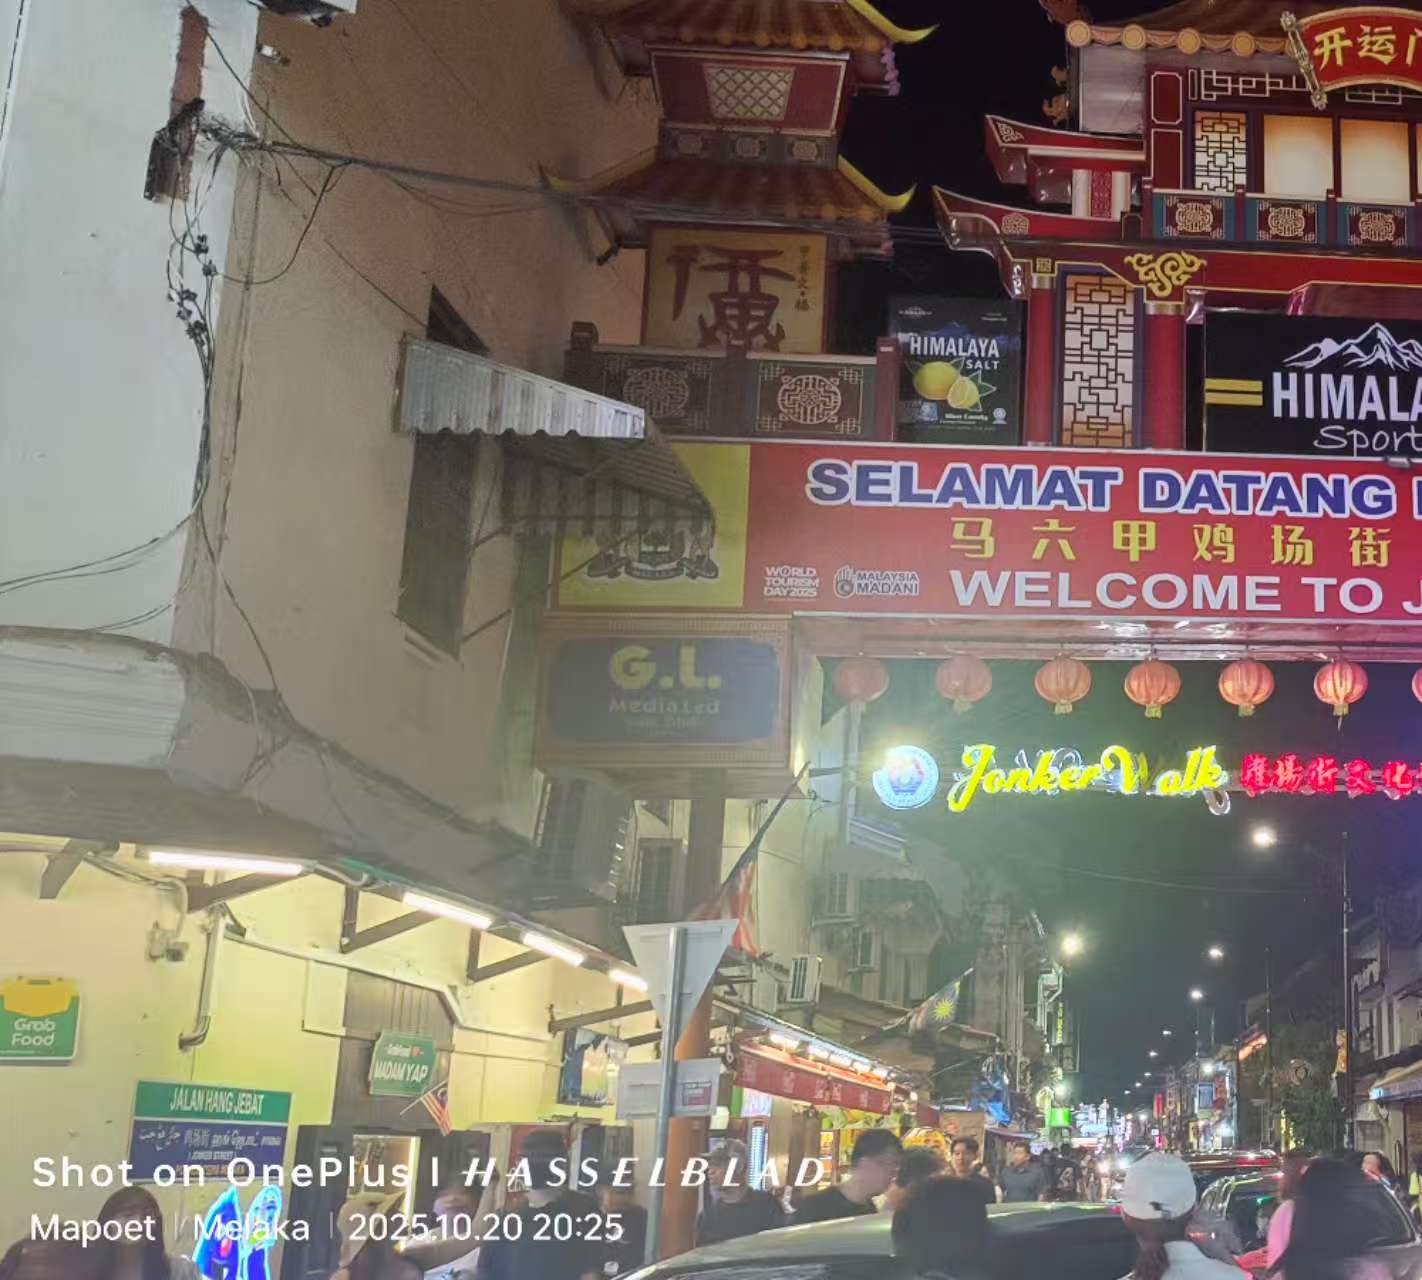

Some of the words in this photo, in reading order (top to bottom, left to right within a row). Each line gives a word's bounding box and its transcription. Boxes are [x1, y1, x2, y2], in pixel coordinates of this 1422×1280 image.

[910, 336, 1000, 358] HIMALAYA
[966, 359, 1000, 370] SALT
[807, 459, 1123, 512] SELAMAT
[1139, 468, 1398, 518] DATANG
[765, 565, 817, 577] WORLD
[856, 570, 919, 582] MALAYSIA
[764, 577, 820, 588] TOURISM
[855, 581, 920, 596] MADANI
[763, 586, 789, 597] DAY
[950, 569, 1281, 611] WELCOME
[1300, 575, 1384, 614] TO
[608, 644, 722, 690] G.L.
[948, 744, 1101, 812] Jonker
[1100, 745, 1229, 796] Walk
[14, 1018, 56, 1032] Grab
[11, 1032, 55, 1047] Food
[406, 1063, 429, 1083] YAP
[170, 1087, 203, 1111] JALAN
[203, 1089, 235, 1113] HANG
[234, 1092, 265, 1115] JEBAT
